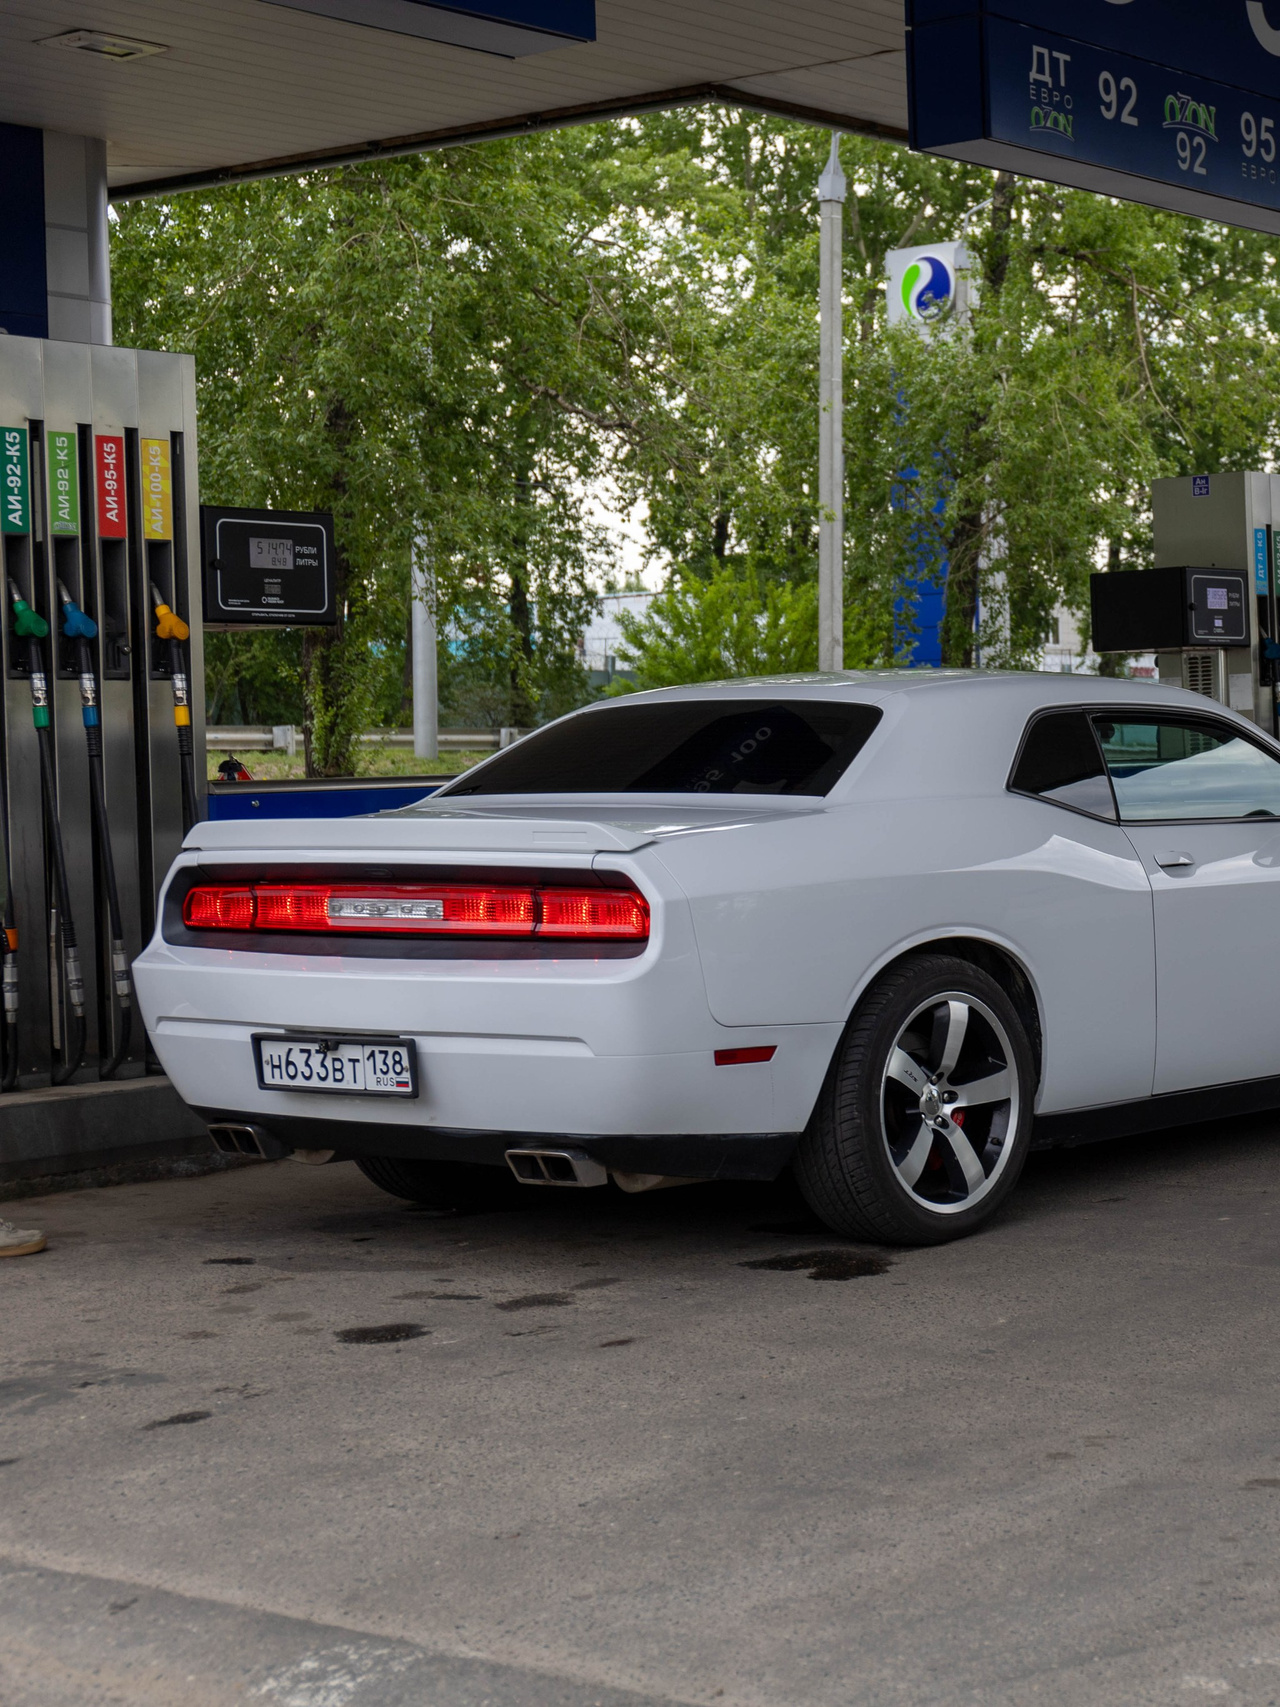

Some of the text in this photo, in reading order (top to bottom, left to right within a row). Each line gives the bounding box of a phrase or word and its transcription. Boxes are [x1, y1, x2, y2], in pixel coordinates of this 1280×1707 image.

[1029, 45, 1071, 88] ДТ
[1029, 84, 1073, 109] ЕВРО
[1098, 70, 1139, 127] 92
[1176, 131, 1207, 175] 92
[1240, 111, 1276, 164] 95
[1241, 162, 1277, 185] ЕВРО
[5, 431, 23, 526] АИ-92-К5
[56, 436, 70, 519] АИ-92-К5
[103, 442, 119, 523] АИ-95-К5
[149, 445, 164, 533] АИ-100-К5
[295, 545, 318, 555] РУБЛИ
[295, 558, 318, 567] ЛИТРЫ
[269, 1048, 404, 1084] Н633ВТ 138
[376, 1077, 395, 1087] RUS
